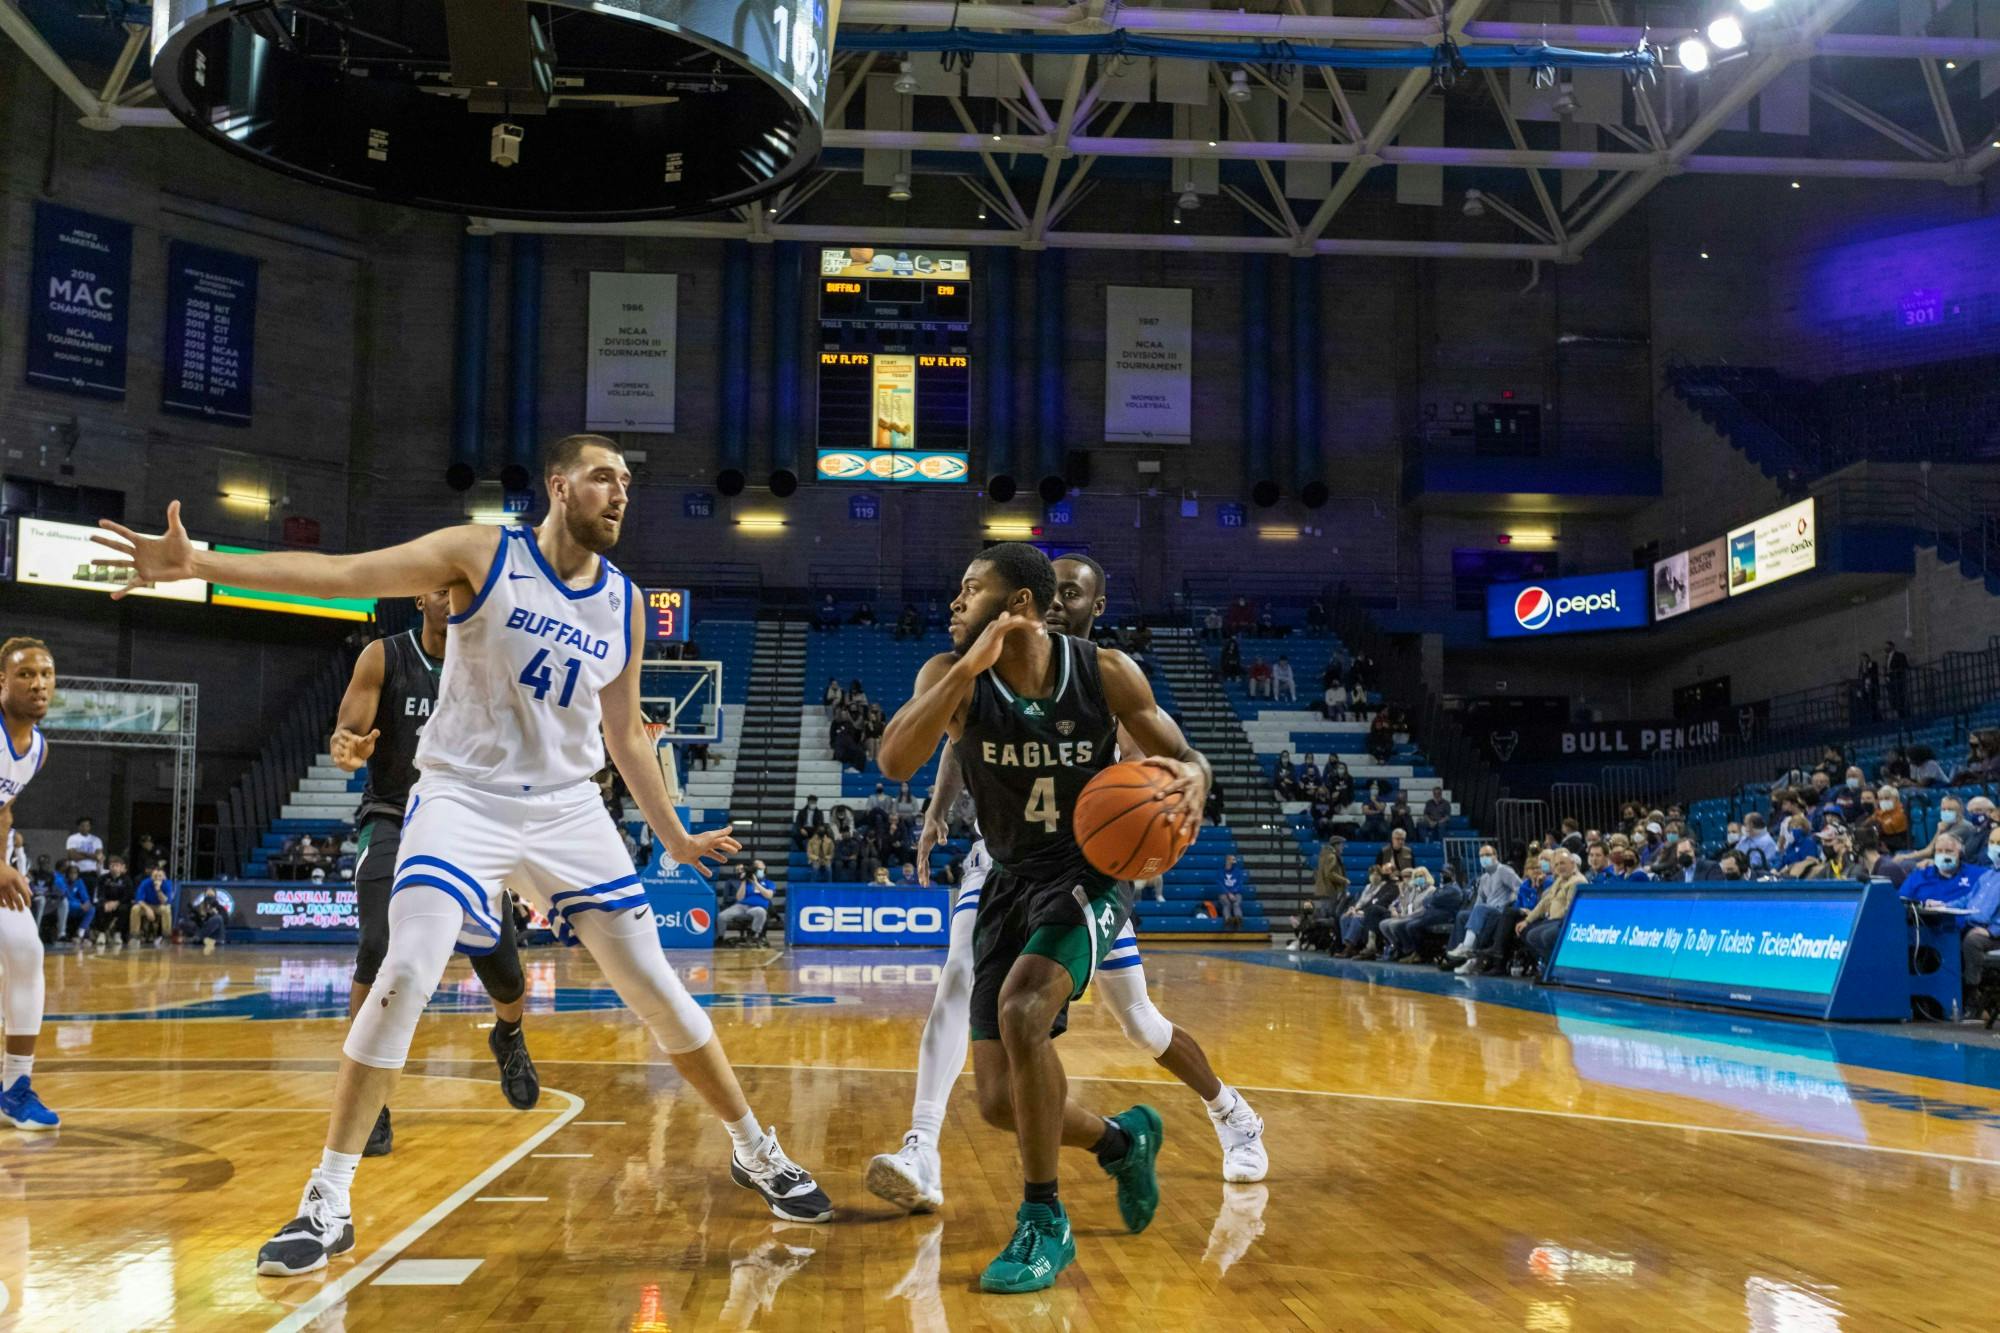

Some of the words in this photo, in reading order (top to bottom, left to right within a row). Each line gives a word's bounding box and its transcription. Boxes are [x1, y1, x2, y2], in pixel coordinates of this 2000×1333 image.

[71, 268, 96, 282] 2019
[50, 276, 114, 310] MAC
[50, 301, 113, 322] CHAMPIONS
[1905, 308, 1934, 325] 301
[66, 327, 95, 340] NCAA
[619, 327, 648, 335] NCAA
[47, 333, 112, 353] TOURNAMENT
[604, 338, 649, 346] DIVISION
[1136, 340, 1164, 349] NCAA
[212, 345, 239, 358] NCAA
[598, 349, 668, 358] TOURNAMENT
[1122, 351, 1165, 361] DIVISION
[212, 356, 239, 369] NCAA
[821, 354, 838, 364] PLY
[851, 355, 869, 365] PTS
[919, 356, 936, 366] PLY
[950, 357, 967, 367] PTS
[1116, 361, 1183, 371] TOURNAMENT
[211, 366, 238, 378] NCAA
[210, 376, 237, 389] NCAA
[509, 499, 529, 511] 117
[690, 505, 709, 516] 118
[855, 507, 875, 518] 119
[1049, 512, 1069, 523] 120
[1222, 514, 1243, 526] 121
[46, 530, 83, 541] difference
[650, 594, 680, 608] 1:09
[1556, 589, 1616, 617] pepsi
[658, 610, 673, 636] 3
[506, 607, 609, 660] BUFFALO
[519, 648, 582, 708] 41
[1561, 730, 1629, 753] BULL
[1641, 728, 1685, 750] PEN
[1688, 720, 1719, 746] CLUB
[982, 741, 1093, 768] EAGLES
[1024, 777, 1060, 833] 4
[273, 890, 332, 903] CASUAL
[256, 903, 294, 914] PIZZA
[800, 906, 942, 933] GEICO
[1568, 922, 1621, 945] TicketSmarter
[1621, 925, 1631, 945] A
[1629, 925, 1664, 948] Smarter
[1663, 927, 1683, 954] Way
[1683, 928, 1697, 950] To
[1695, 928, 1717, 957] Buy
[1717, 929, 1755, 954] Tickets
[1758, 931, 1848, 960] TicketSmarter
